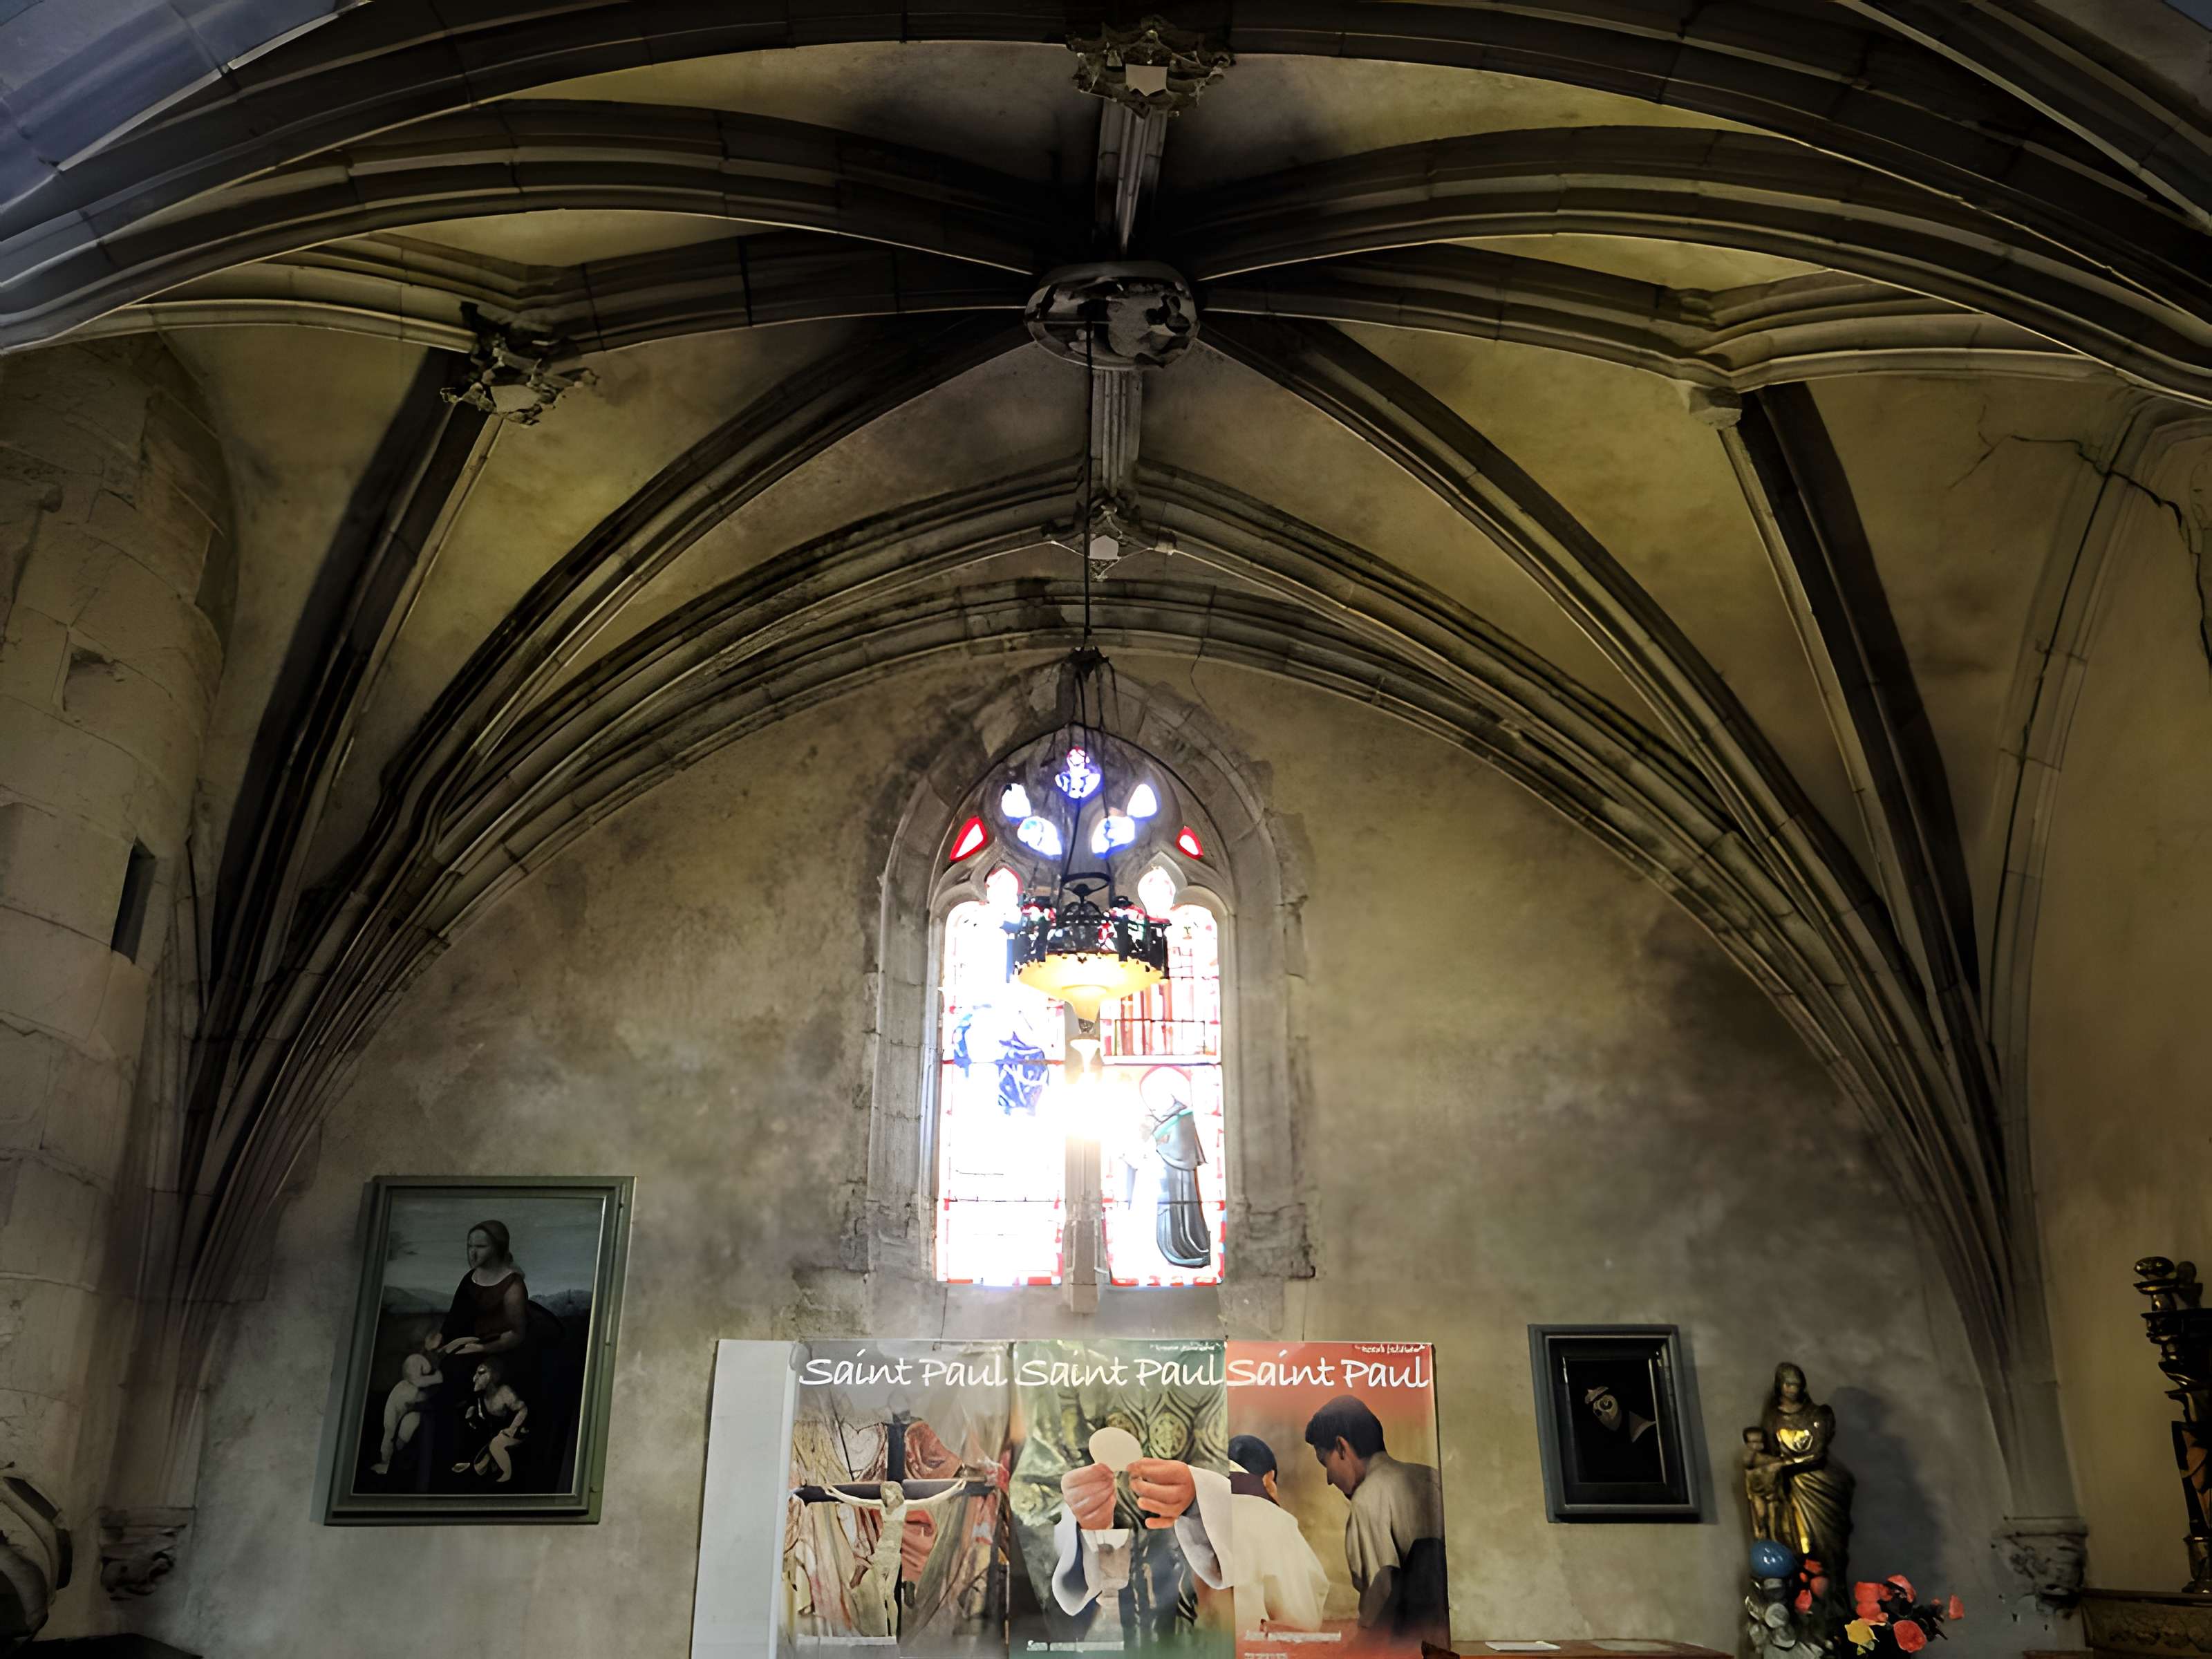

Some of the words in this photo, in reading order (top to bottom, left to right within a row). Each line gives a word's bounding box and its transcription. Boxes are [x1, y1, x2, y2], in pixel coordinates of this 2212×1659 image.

[798, 1349, 912, 1385] Saint
[919, 1354, 1008, 1386] Paul
[1015, 1349, 1128, 1387] Saint
[1134, 1354, 1224, 1387] Paul
[1226, 1349, 1335, 1387] Saint
[1340, 1356, 1429, 1388] Paul
